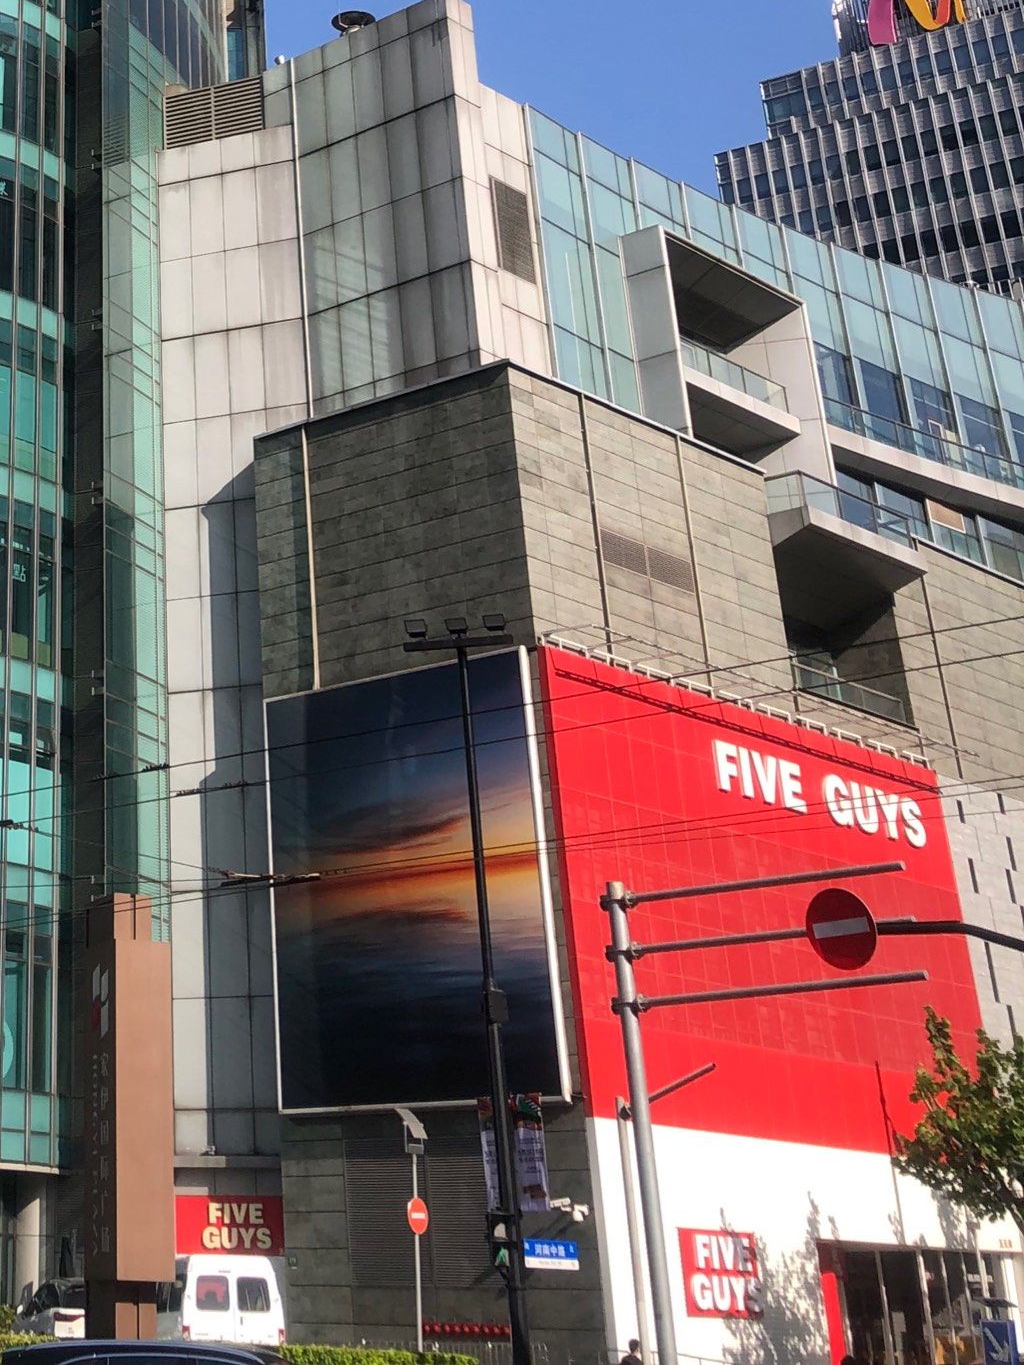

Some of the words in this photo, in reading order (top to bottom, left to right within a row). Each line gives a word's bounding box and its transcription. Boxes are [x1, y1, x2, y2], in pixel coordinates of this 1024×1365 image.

[712, 739, 808, 815] FIVE
[823, 774, 927, 849] GUYS
[208, 1202, 264, 1225] FIVE
[202, 1226, 273, 1250] GUYS
[694, 1234, 754, 1272] FIVE
[690, 1272, 765, 1313] GUYS
